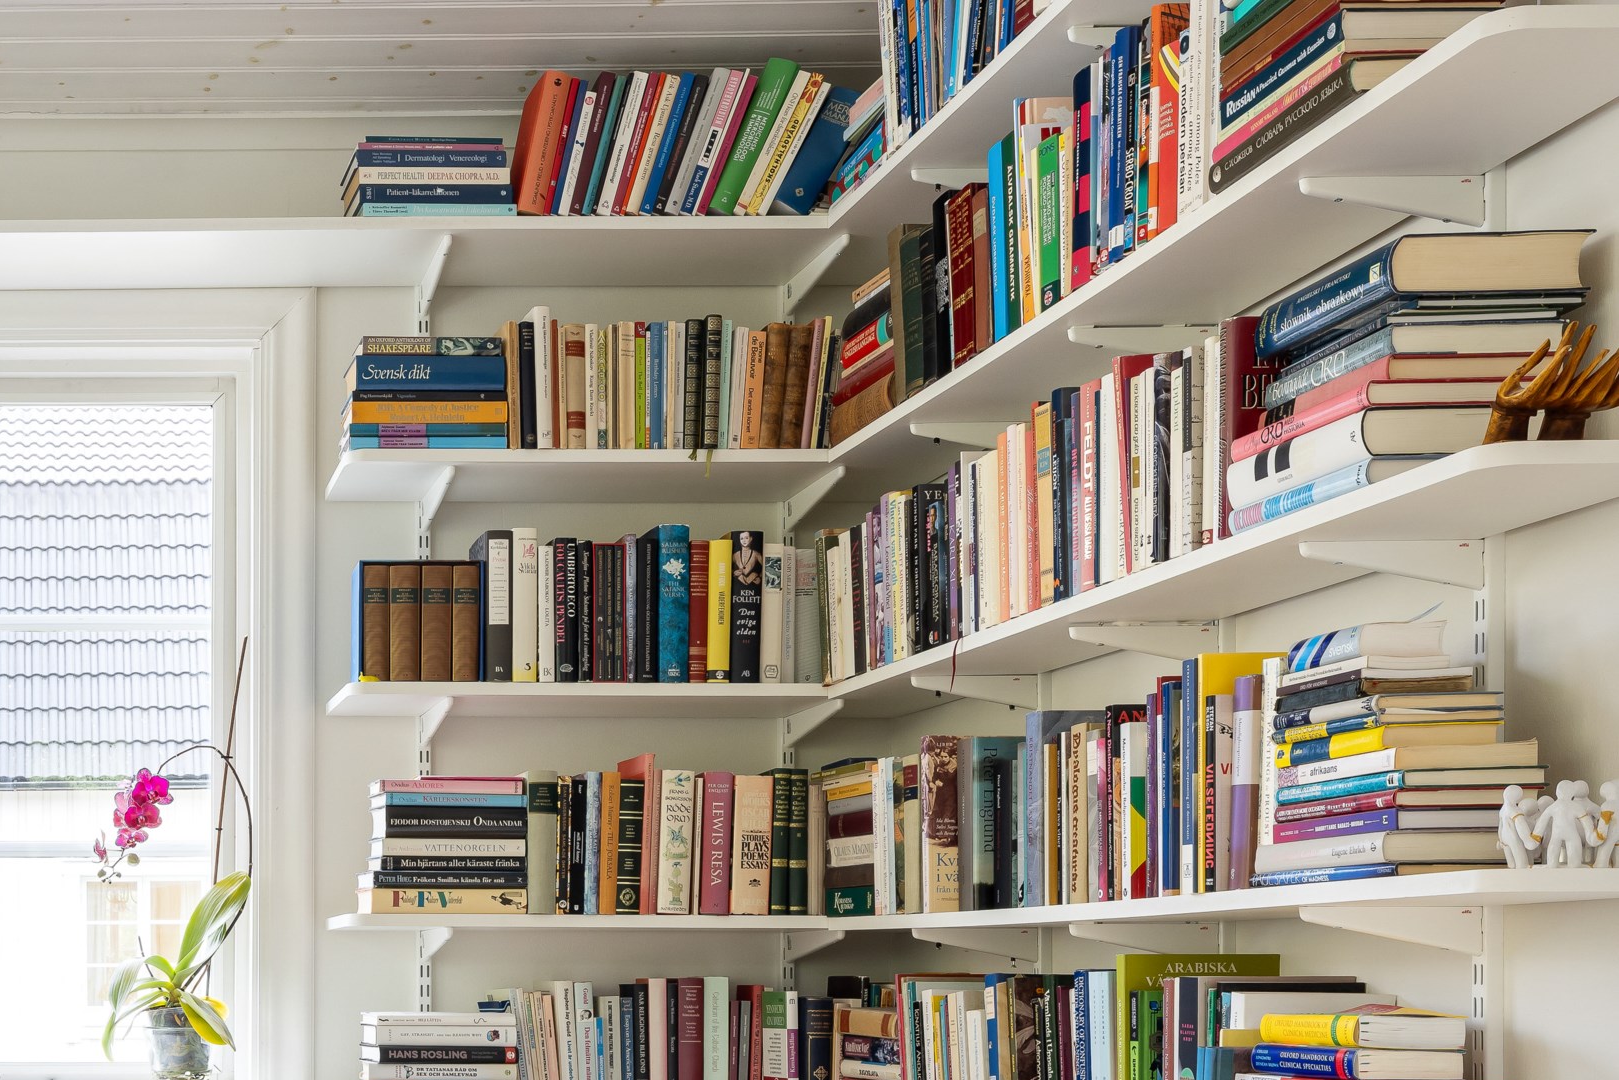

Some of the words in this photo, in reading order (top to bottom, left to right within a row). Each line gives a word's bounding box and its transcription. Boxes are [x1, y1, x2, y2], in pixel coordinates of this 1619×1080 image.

[1180, 84, 1188, 140] modern
[1256, 121, 1284, 149] СЛОВАРЬ
[1285, 96, 1319, 128] РУССКОГО
[1320, 76, 1343, 101] ЯЗЫКА
[1039, 143, 1055, 158] PONS
[405, 155, 445, 163] Dermatologi
[449, 155, 488, 163] Venereologi
[378, 171, 402, 180] PERFECT
[403, 171, 425, 180] HEALTH
[428, 172, 453, 180] DEEPAK
[455, 172, 484, 181] CHOPRA,
[486, 172, 500, 180] M.D.
[1179, 144, 1187, 195] persian
[1124, 147, 1135, 210] SERBO-CROAT
[1280, 311, 1312, 333] słownik
[1316, 283, 1364, 315] obrazkowy
[367, 345, 431, 353] SHAKESPEARE
[749, 347, 758, 379] Beauvoir
[362, 364, 408, 380] Svensk
[409, 364, 431, 380] dikt
[1084, 420, 1093, 492] FELDT
[1084, 495, 1092, 514] ALLA
[1084, 514, 1092, 536] DESSA
[1084, 537, 1092, 560] DAGAR
[556, 543, 565, 602] FOUCAULTS
[567, 543, 576, 593] UMBERTO
[567, 595, 576, 617] ECO
[739, 608, 755, 616] Den
[556, 605, 565, 645] PENDEL
[736, 619, 757, 627] eviga
[1329, 640, 1354, 658] svensk
[983, 747, 998, 784] Peter
[1309, 764, 1338, 777] afrikaans
[390, 818, 419, 826] FJODOR
[420, 818, 471, 826] DOSTOJEVSKIJ
[473, 816, 497, 827] ONDA
[712, 802, 724, 845] LEWIS
[979, 789, 997, 853] Englund
[741, 834, 770, 842] STORIES
[424, 844, 506, 852] VATTENORGELN
[741, 842, 770, 852] PLAYS
[1332, 847, 1348, 859] Eugene
[1349, 844, 1366, 856] Ehrlich
[400, 859, 417, 867] Min
[417, 859, 448, 869] hjärtans
[448, 859, 465, 867] aller
[466, 859, 494, 867] käraste
[495, 858, 520, 867] fränka
[741, 852, 769, 861] POEMS
[710, 852, 723, 886] RESA
[740, 861, 769, 870] ESSAYS
[1165, 962, 1237, 973] ARABISKA
[1078, 976, 1086, 1024] DICTIONARY
[1282, 1029, 1302, 1037] CLINICAL
[1302, 1030, 1328, 1039] MEDICINE
[388, 1050, 419, 1059] HANS
[421, 1050, 468, 1059] ROSLING
[1280, 1051, 1300, 1060] OXFORD
[1300, 1052, 1327, 1061] HANDBOOK
[1279, 1061, 1302, 1070] CLINICAL
[1302, 1062, 1332, 1072] SPECIALTIES
